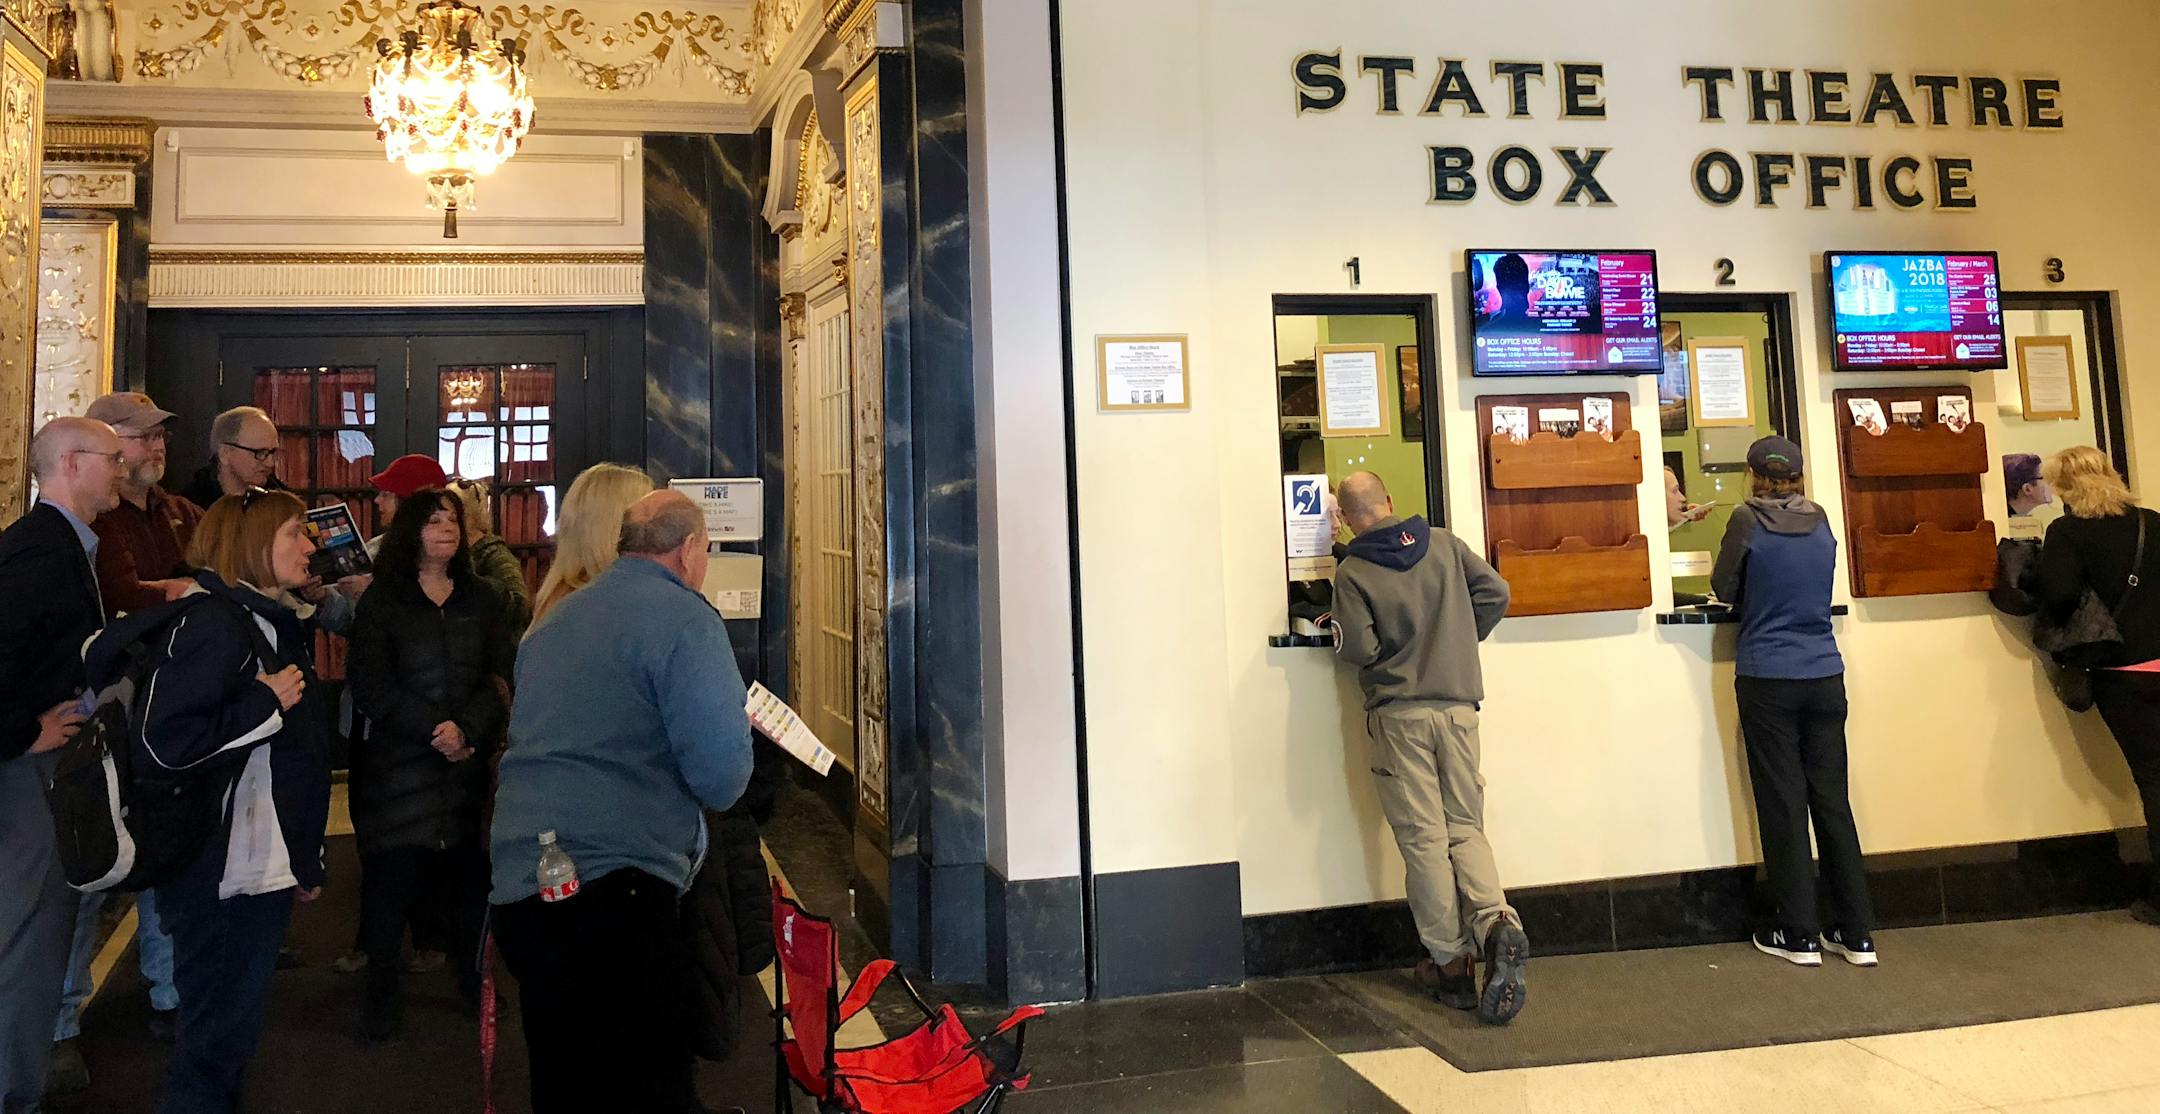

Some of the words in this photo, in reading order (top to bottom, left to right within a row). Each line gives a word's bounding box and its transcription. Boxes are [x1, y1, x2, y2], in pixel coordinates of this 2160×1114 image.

[1291, 46, 1608, 120] STATE
[1681, 65, 2065, 133] THEATRE
[1423, 143, 1618, 208] BOX
[1691, 147, 1978, 213] OFFICE
[1600, 258, 1625, 268] February
[1902, 258, 1945, 272] JAZBA
[1947, 260, 1969, 268] February
[1346, 256, 1360, 285] 1
[1717, 258, 1736, 285] 2
[2047, 257, 2065, 283] 3
[1536, 275, 1574, 289] DAVID
[1640, 273, 1653, 286] 21
[1909, 272, 1946, 286] 2018
[1983, 273, 1997, 286] 25
[1545, 286, 1586, 299] BOWIE
[1641, 287, 1656, 300] 22
[1984, 287, 1998, 299] 03
[1642, 301, 1656, 314] 23
[1985, 300, 1999, 312] 06
[1643, 315, 1657, 328] 24
[1987, 313, 2000, 326] 14
[1521, 337, 1542, 345] HOURS
[704, 485, 729, 493] MADE
[1772, 928, 1787, 945] N
